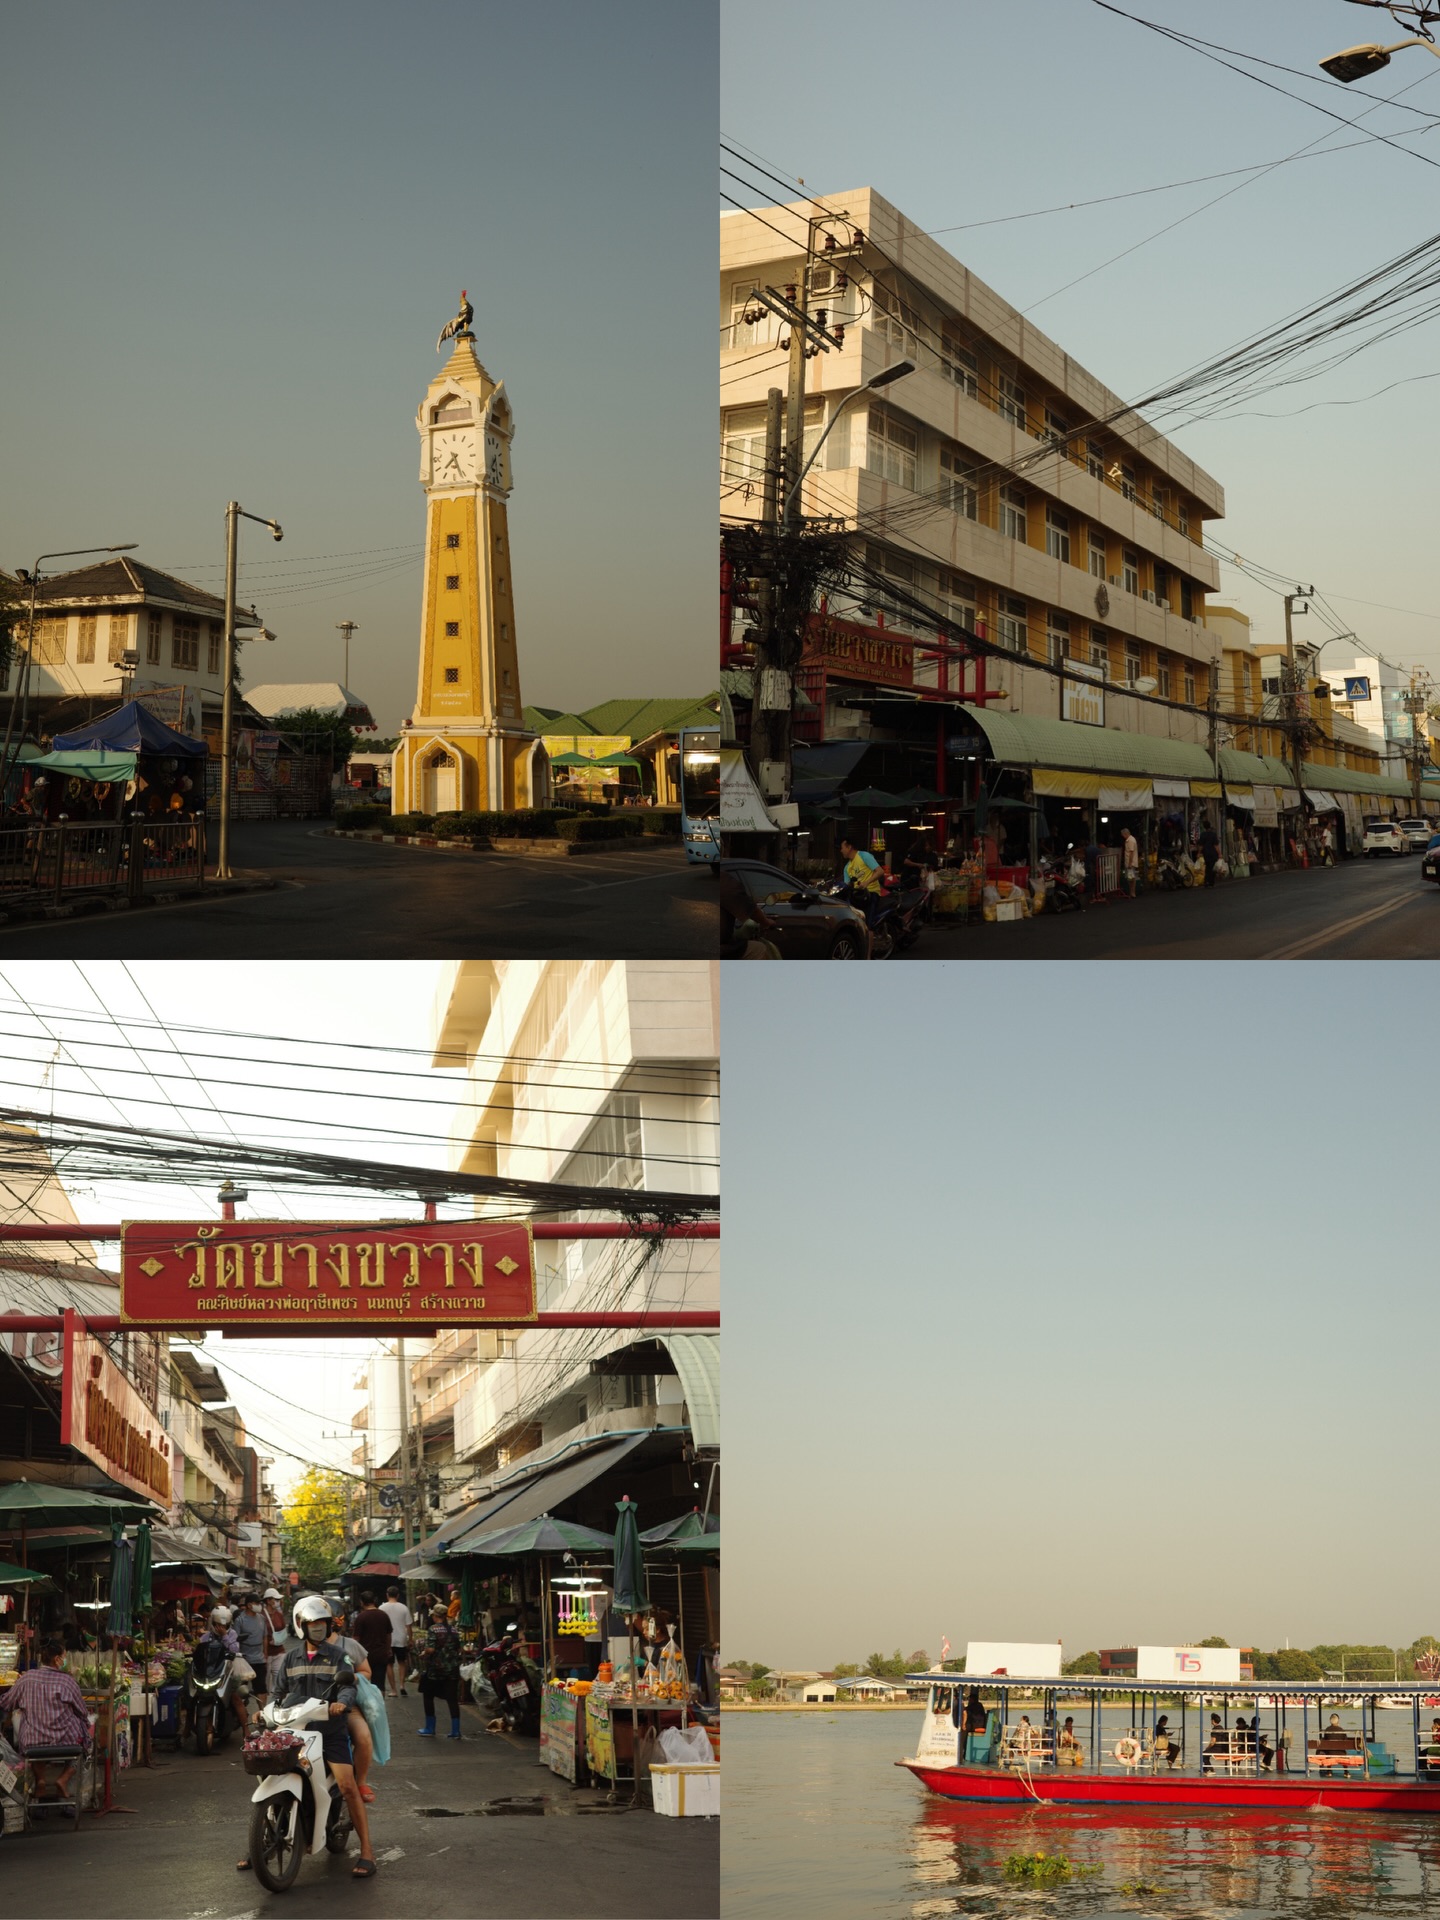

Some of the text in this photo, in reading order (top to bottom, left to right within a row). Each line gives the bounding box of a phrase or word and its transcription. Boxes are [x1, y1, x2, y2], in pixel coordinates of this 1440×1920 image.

[174, 1226, 485, 1289] วัดบางขวาง
[367, 1292, 411, 1314] นนทบุรี
[420, 1292, 485, 1309] สร้างถวาย
